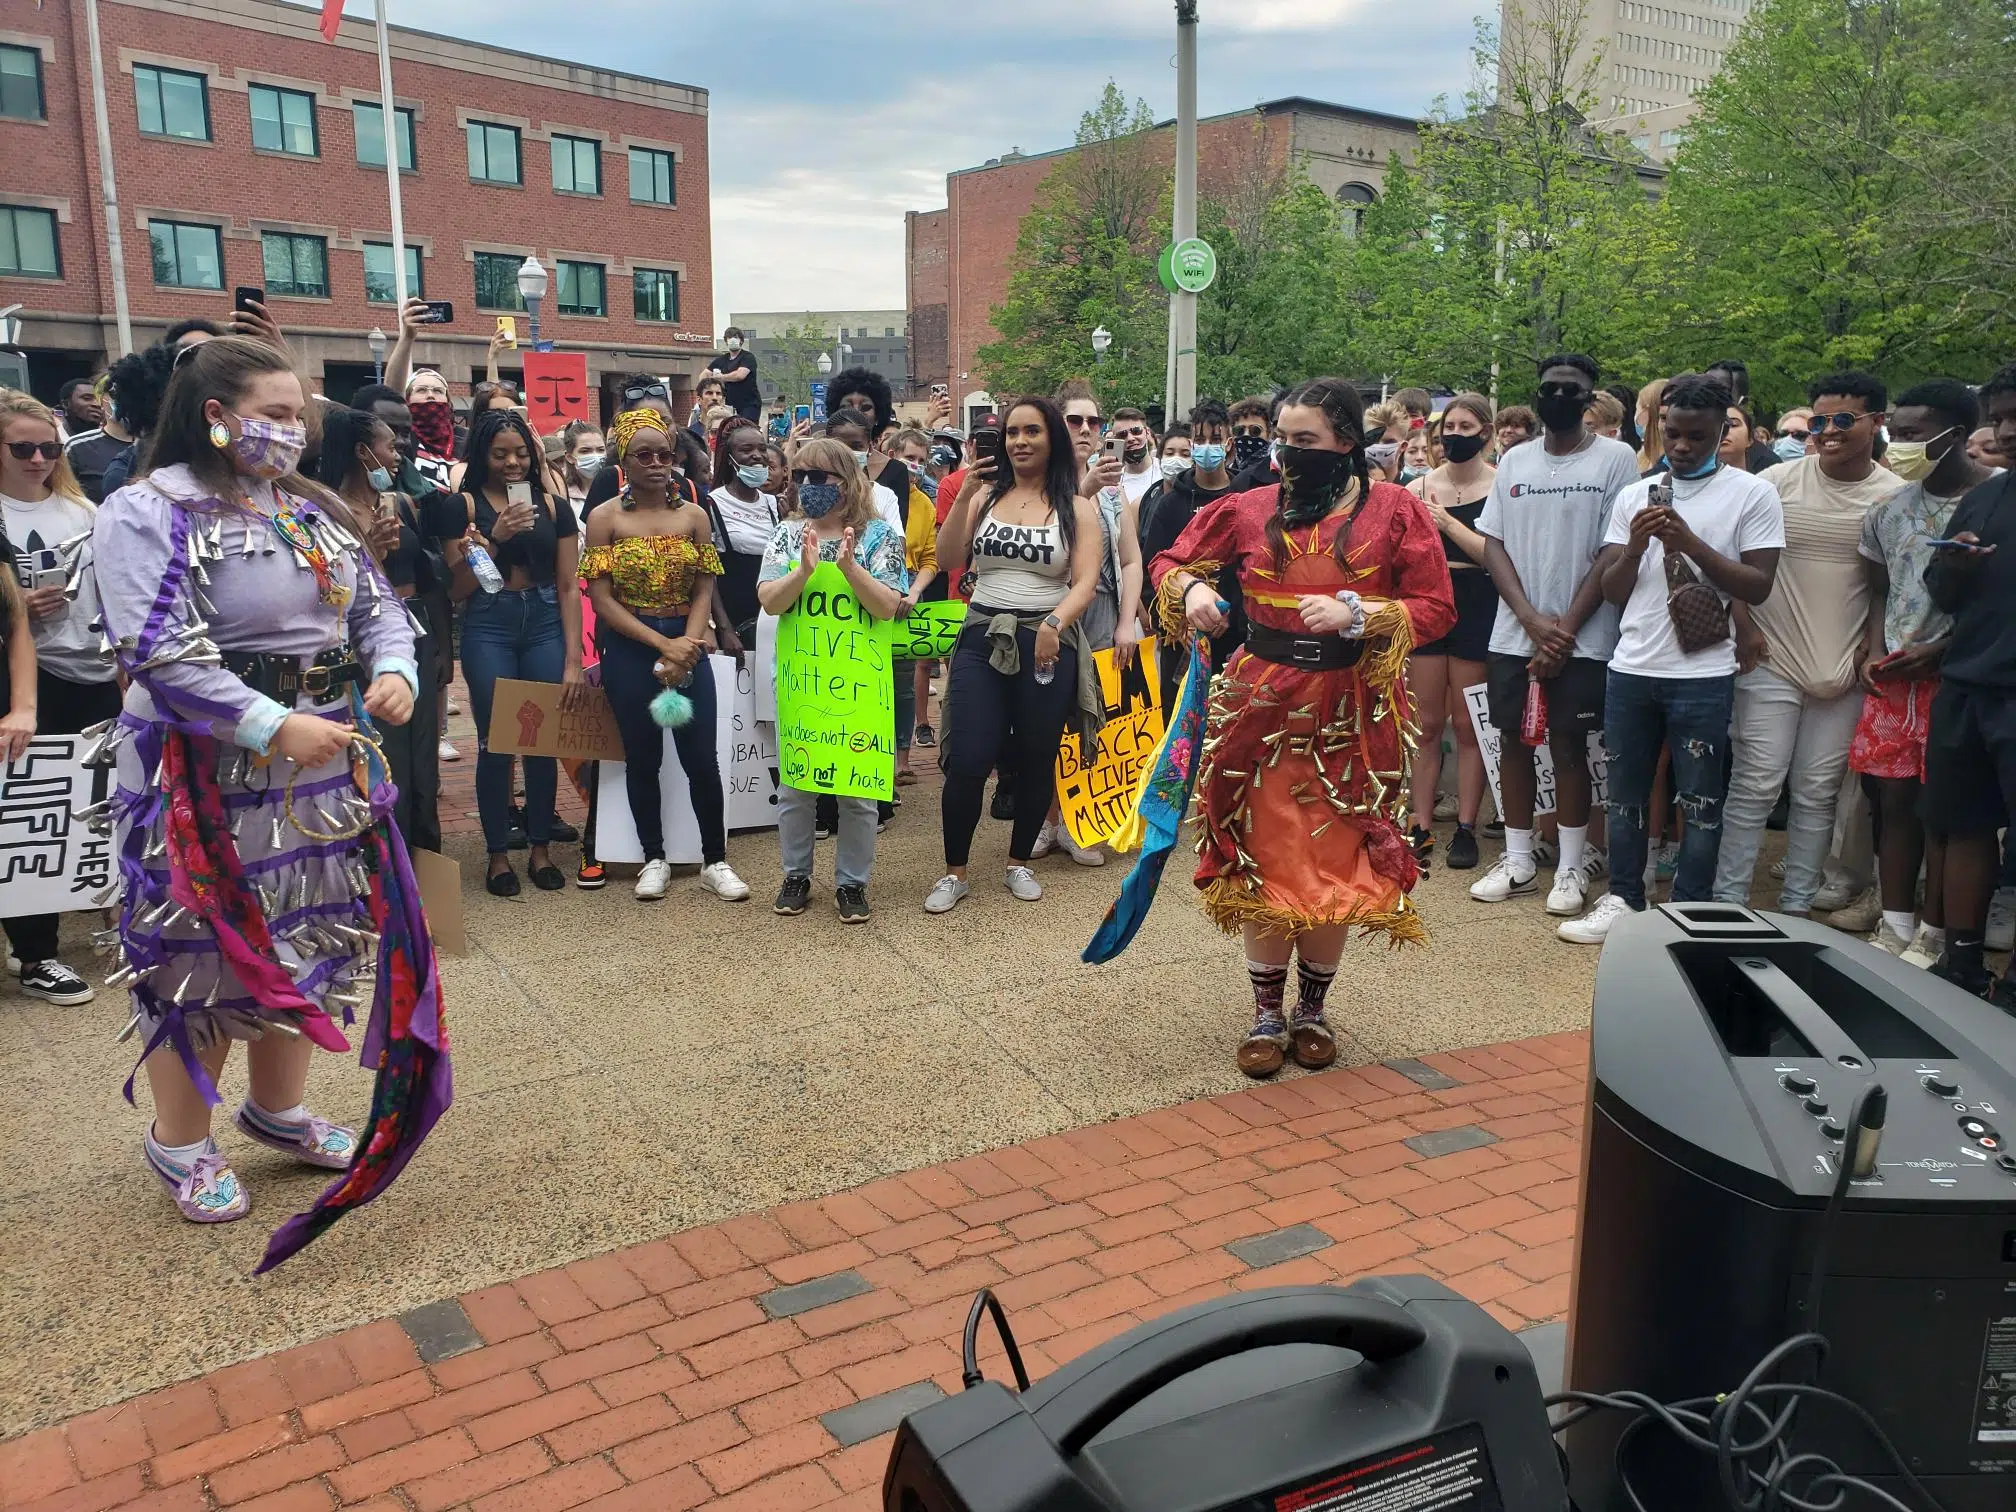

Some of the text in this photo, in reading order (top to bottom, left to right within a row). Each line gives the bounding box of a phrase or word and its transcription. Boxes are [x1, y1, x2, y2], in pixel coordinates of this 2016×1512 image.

[1509, 482, 1606, 499] Champion
[982, 522, 1050, 544] DON'T
[973, 536, 1055, 565] SHOOT
[794, 623, 884, 671] LIVES
[782, 659, 868, 701] Matter
[560, 714, 602, 732] LIVES
[557, 732, 609, 750] MATTER
[1058, 715, 1155, 779] BACK
[813, 762, 837, 781] not
